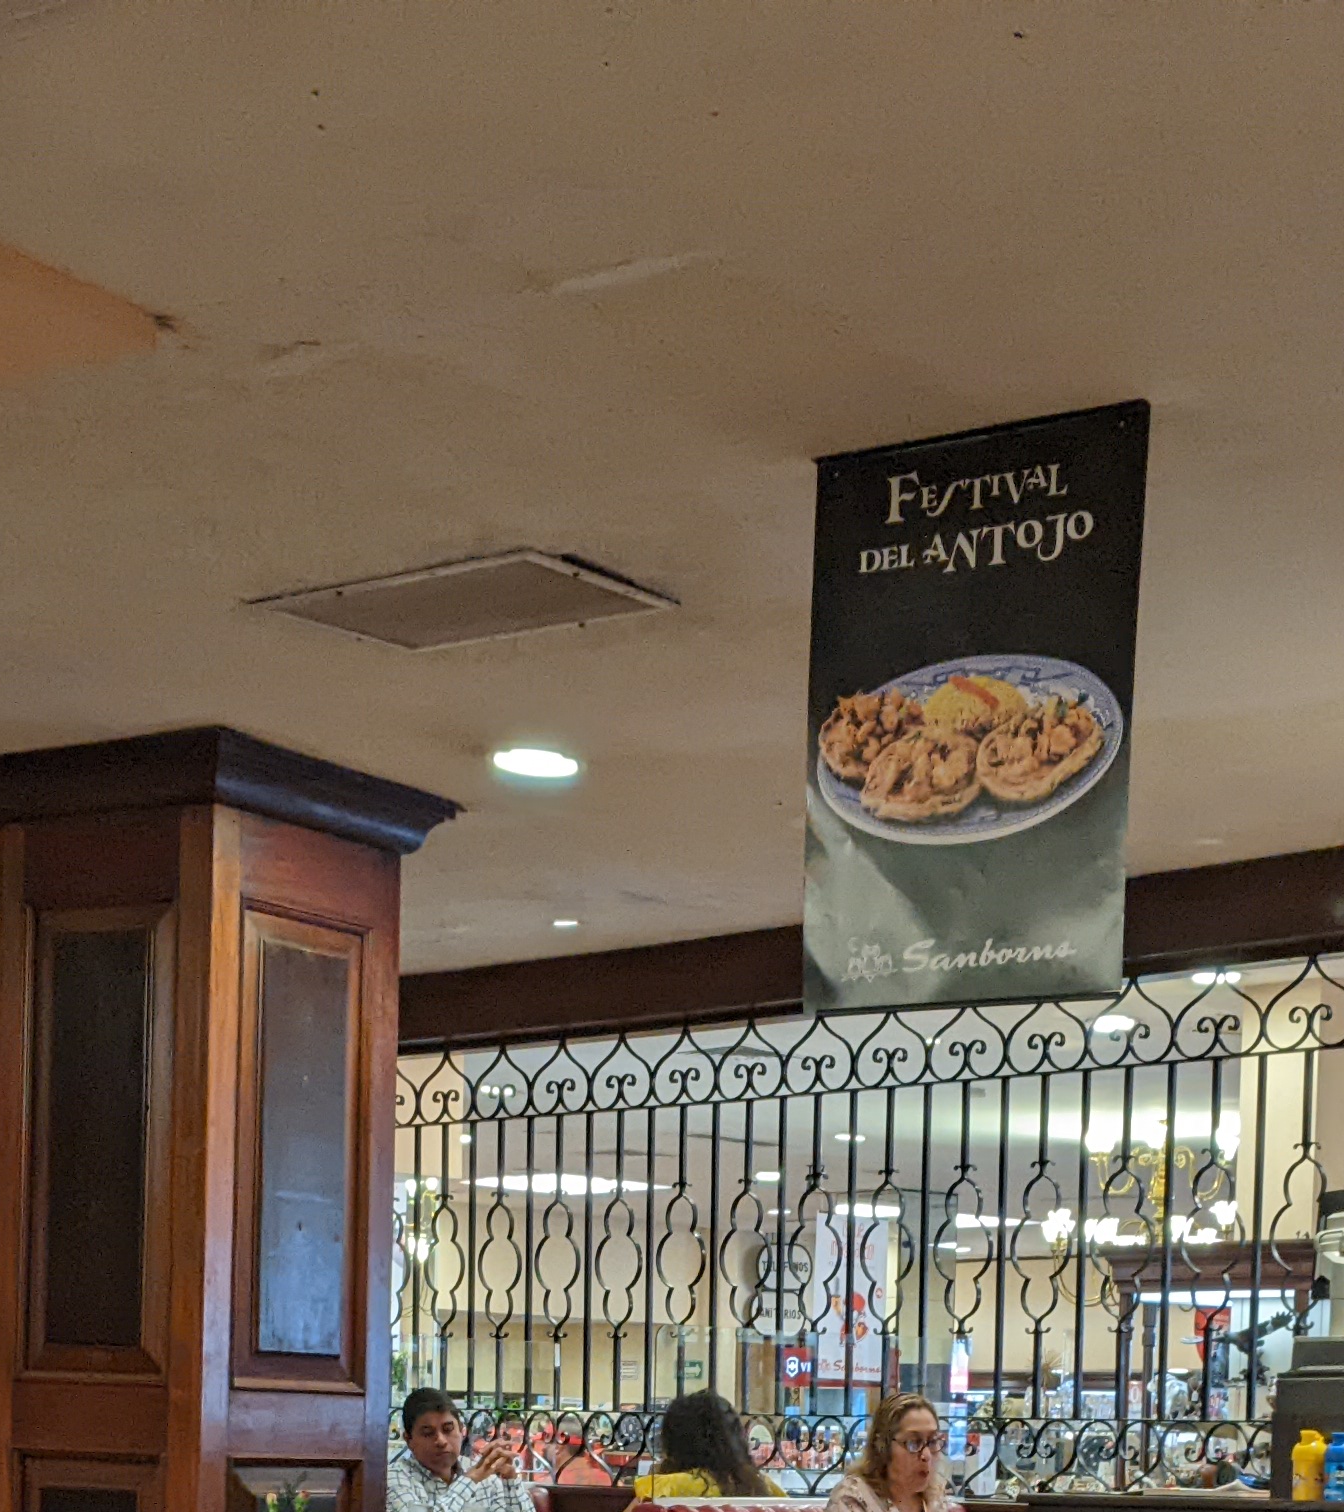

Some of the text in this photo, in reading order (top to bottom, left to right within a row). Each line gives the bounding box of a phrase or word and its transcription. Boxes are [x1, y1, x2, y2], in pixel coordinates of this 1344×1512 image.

[858, 509, 1095, 574] DEL ANTOJO
[901, 937, 1077, 973] Sanborns
